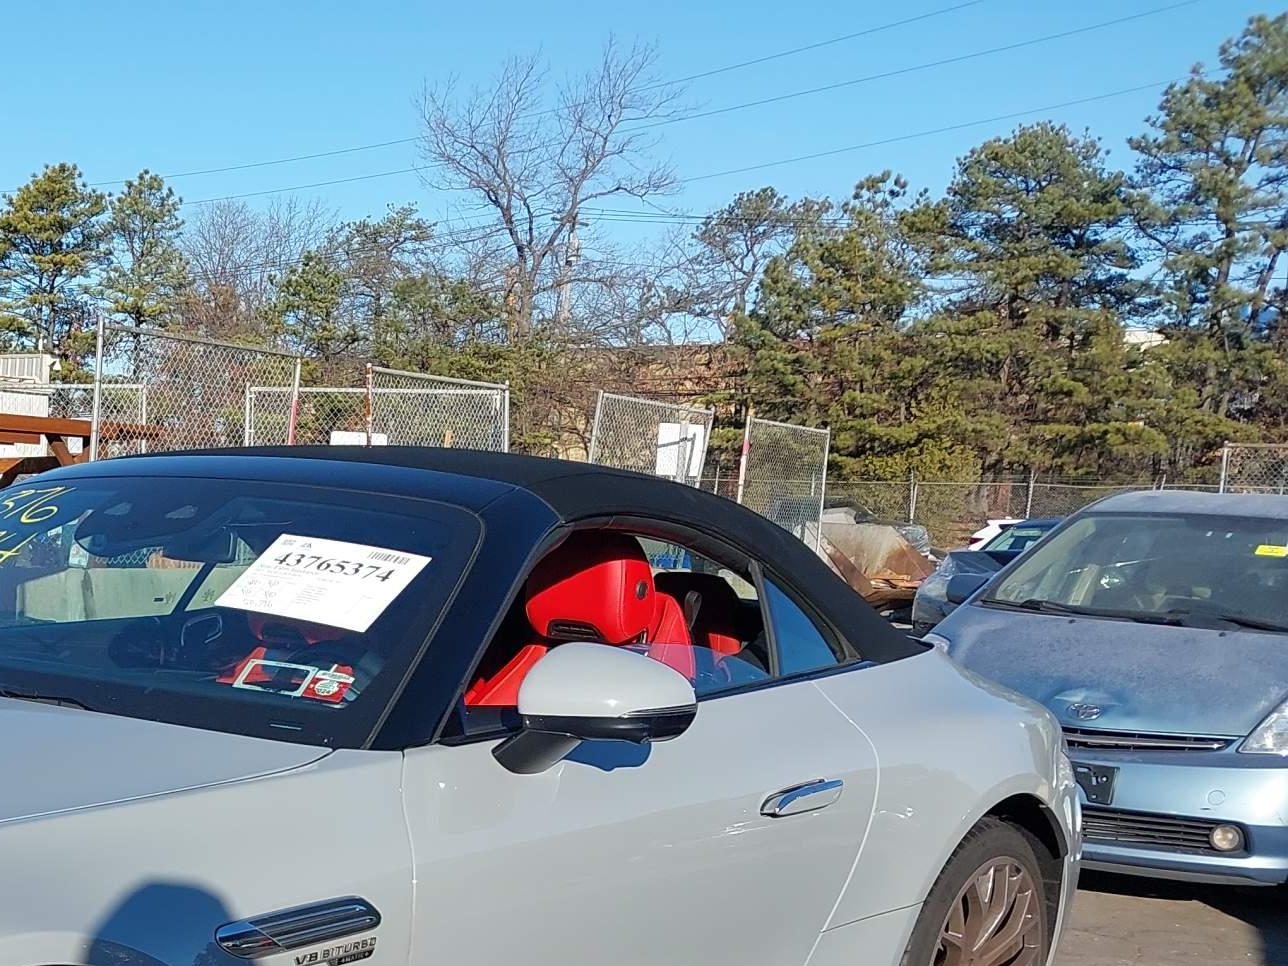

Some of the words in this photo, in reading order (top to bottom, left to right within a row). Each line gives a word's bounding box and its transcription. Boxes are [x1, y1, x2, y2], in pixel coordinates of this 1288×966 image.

[274, 552, 395, 582] 43765374
[295, 952, 319, 965] V8
[322, 937, 376, 958] BITURBO
